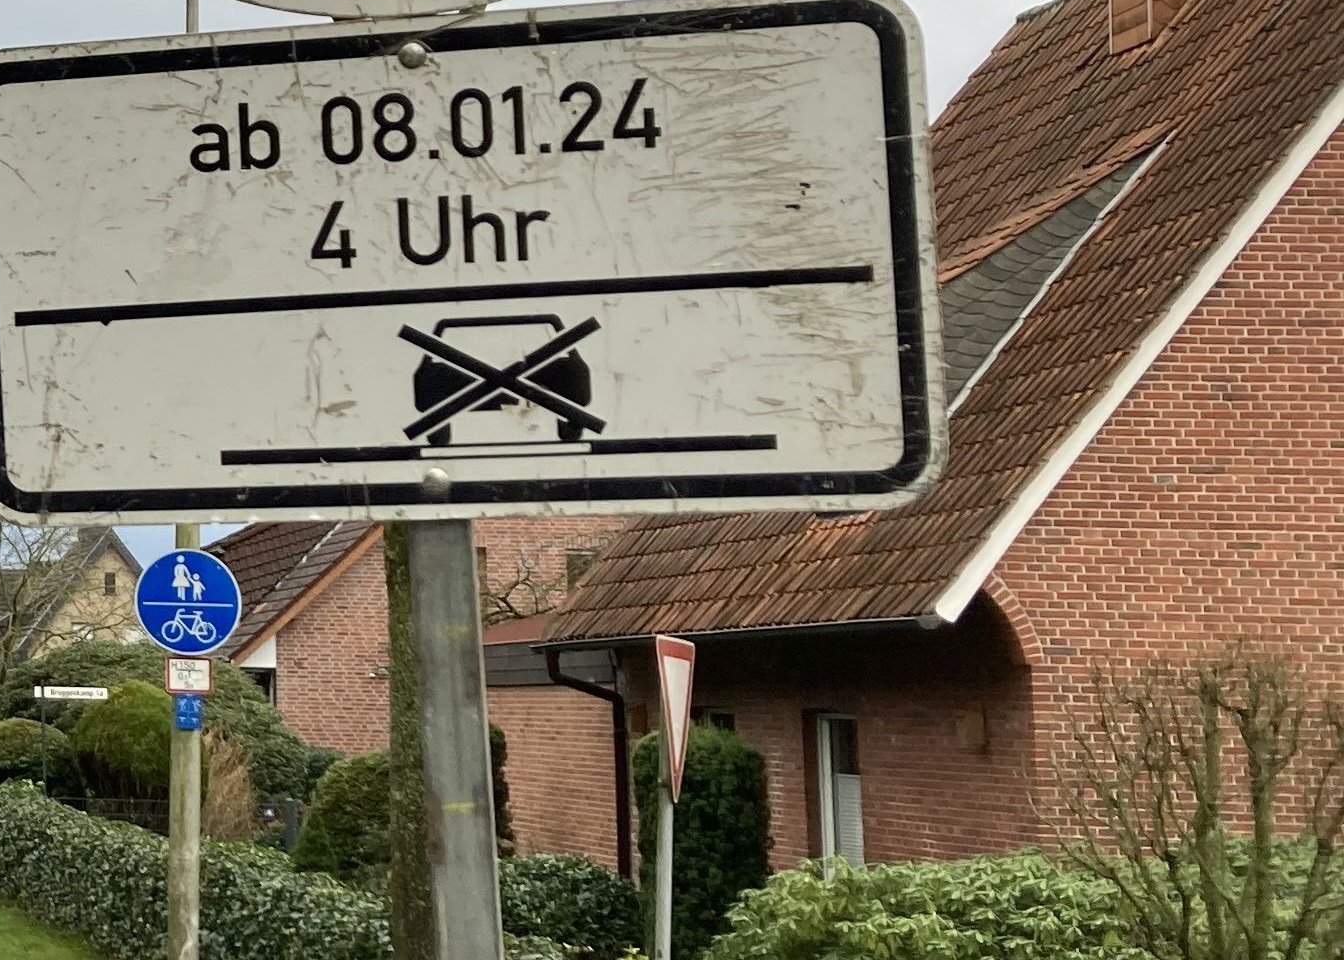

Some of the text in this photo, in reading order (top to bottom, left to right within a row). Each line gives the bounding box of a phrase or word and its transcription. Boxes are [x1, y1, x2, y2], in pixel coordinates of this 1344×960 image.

[190, 78, 661, 172] ab 08.01.24
[311, 195, 550, 268] 4 Uhr
